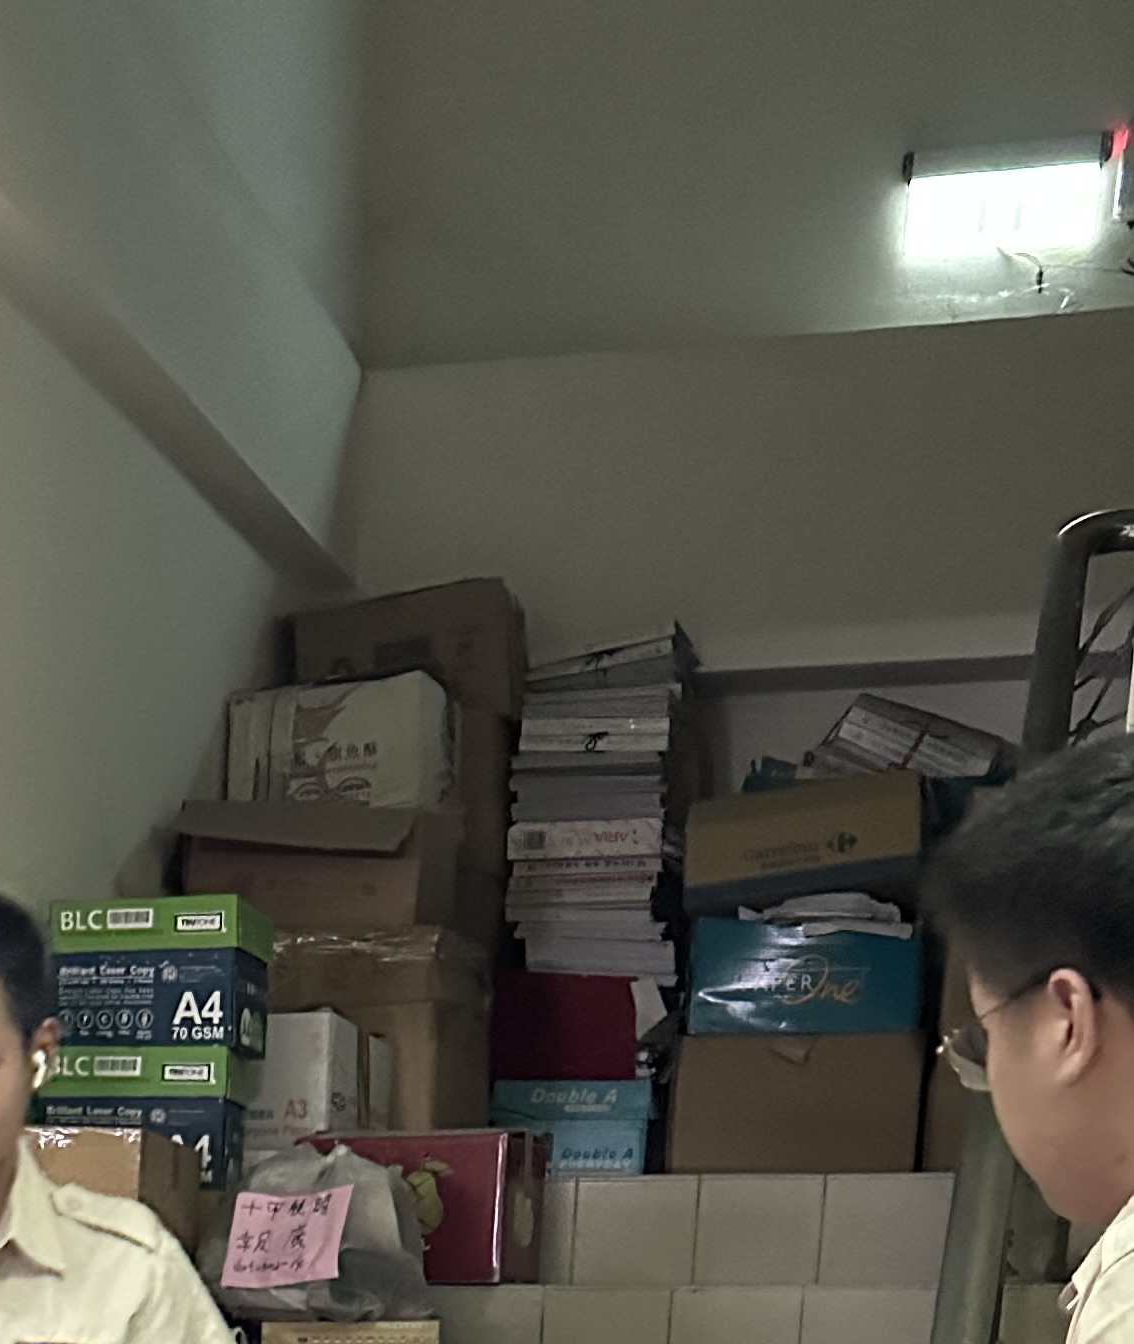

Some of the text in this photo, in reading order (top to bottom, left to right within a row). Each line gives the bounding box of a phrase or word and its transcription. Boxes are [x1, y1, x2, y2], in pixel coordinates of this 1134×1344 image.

[60, 910, 103, 931] BLC
[172, 990, 224, 1025] A4
[172, 1026, 224, 1040] 70 GSM
[531, 1088, 617, 1104] Double A
[285, 1099, 307, 1119] A3
[561, 1147, 633, 1160] Double A
